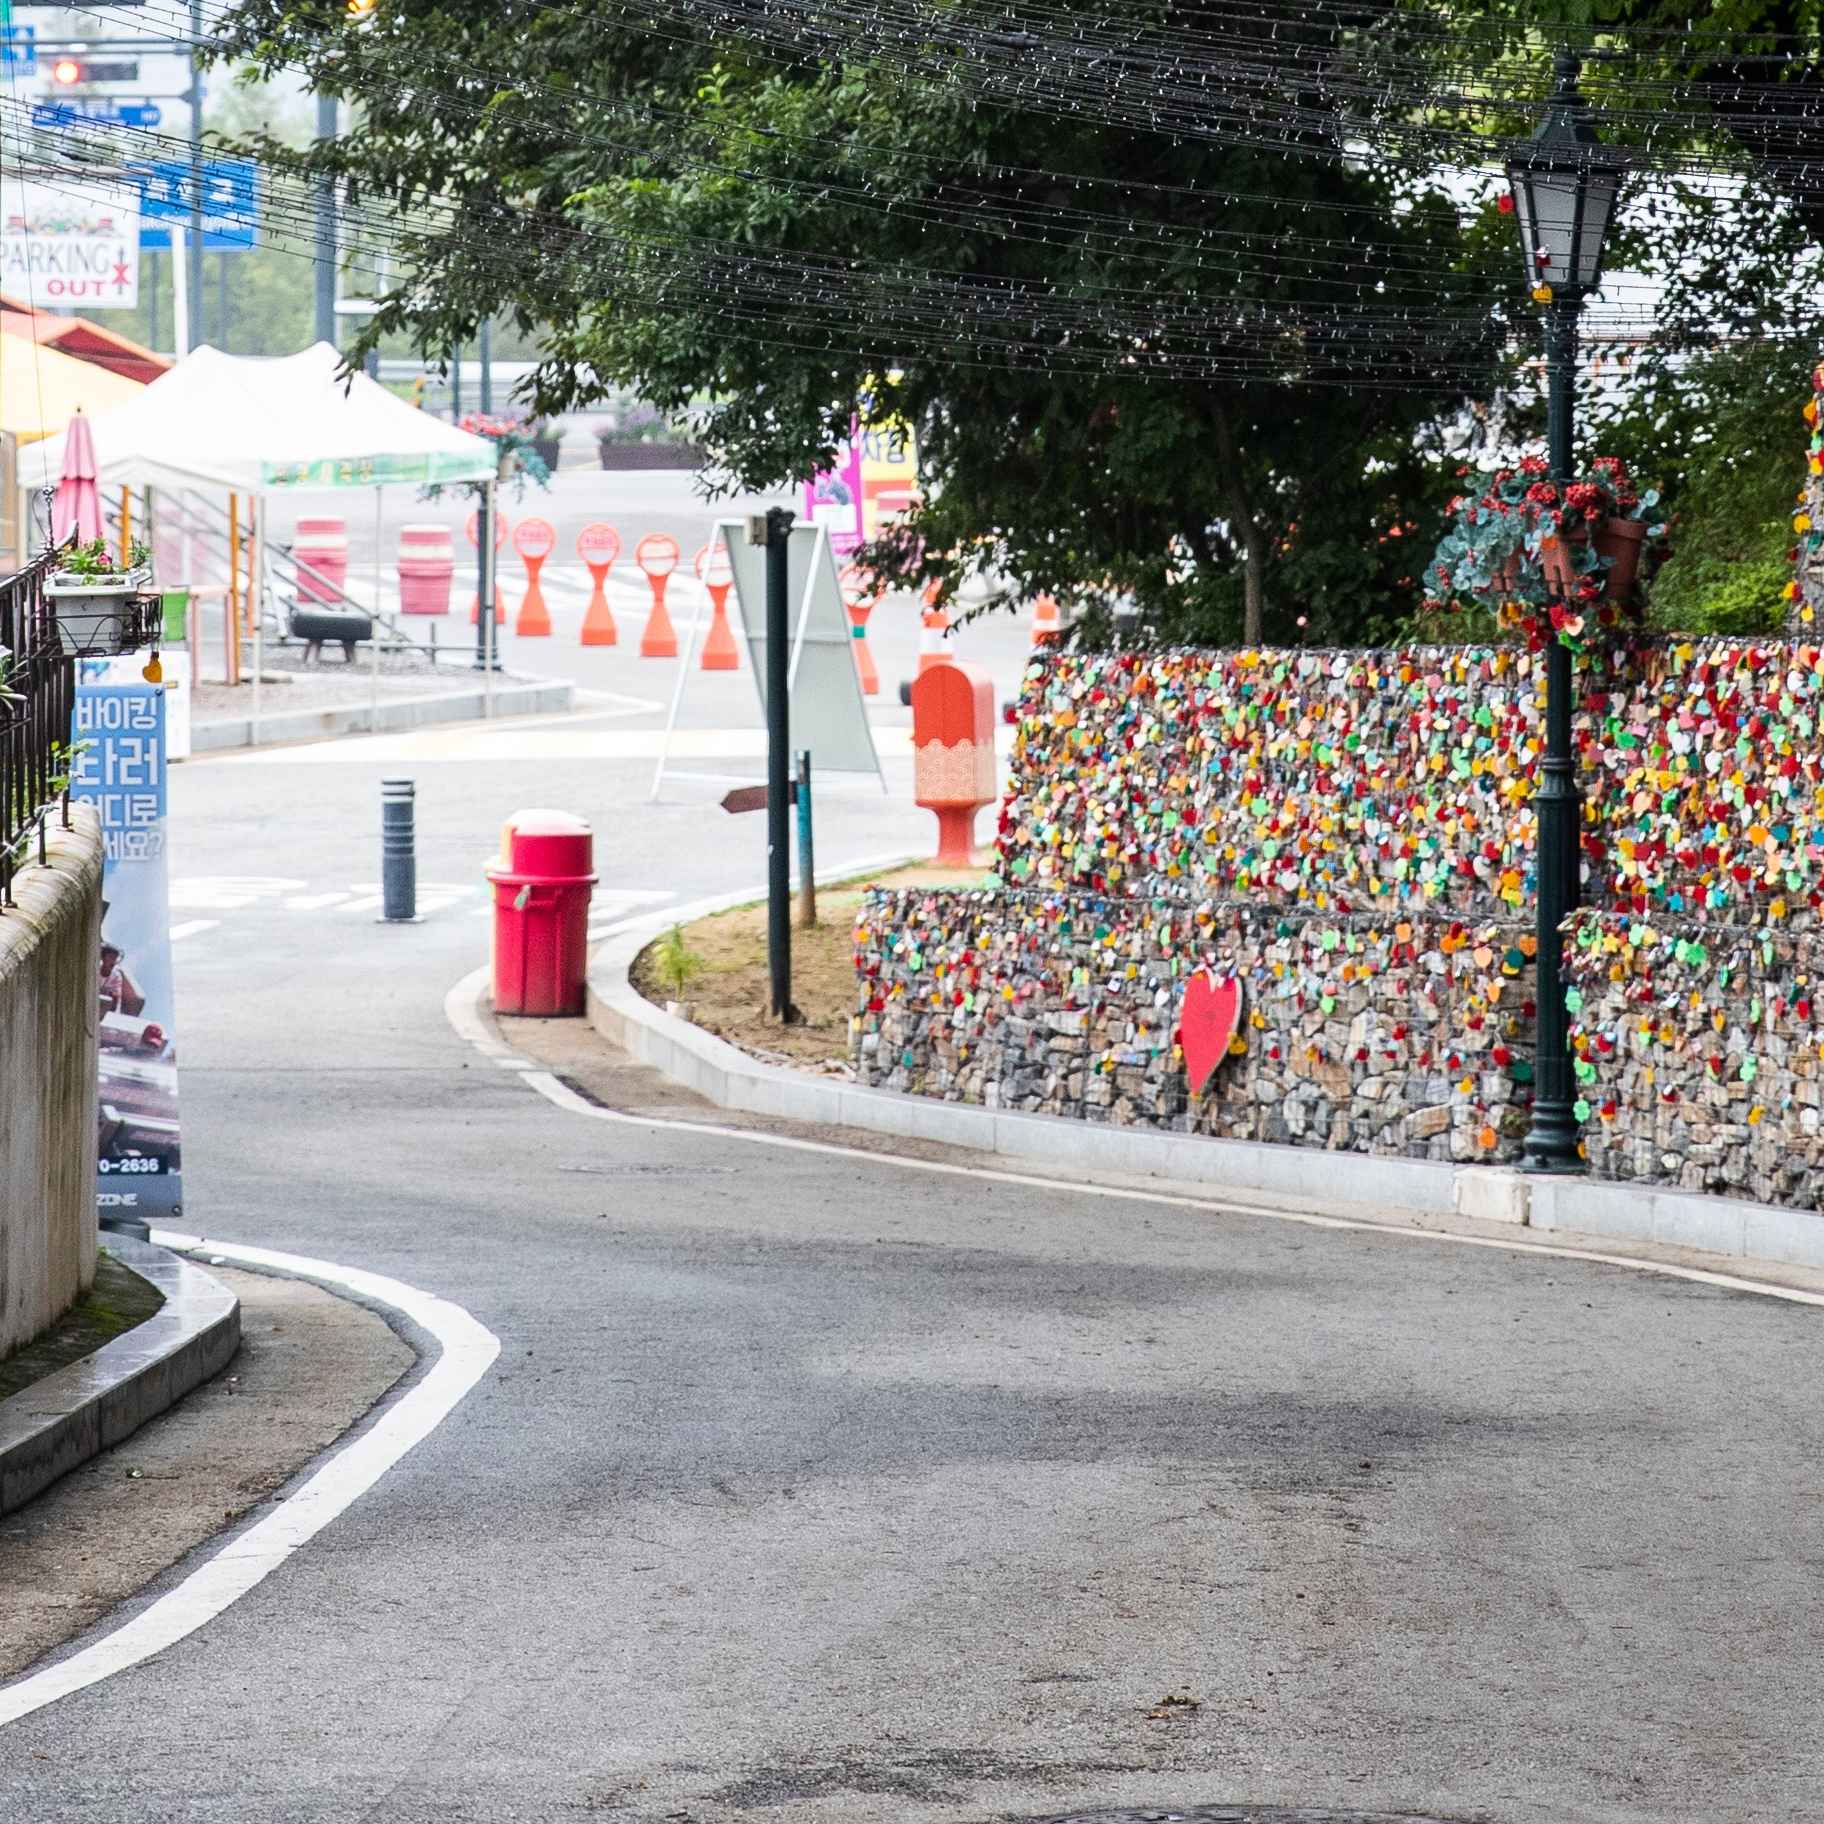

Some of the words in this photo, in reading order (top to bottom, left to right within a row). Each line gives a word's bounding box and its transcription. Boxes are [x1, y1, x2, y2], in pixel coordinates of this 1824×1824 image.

[47, 279, 106, 296] OUT
[77, 696, 157, 730] 바이킹
[77, 737, 159, 786] 타러
[77, 793, 158, 826] 어디로
[102, 830, 162, 861] 세요?
[98, 1158, 160, 1173] 0-2636
